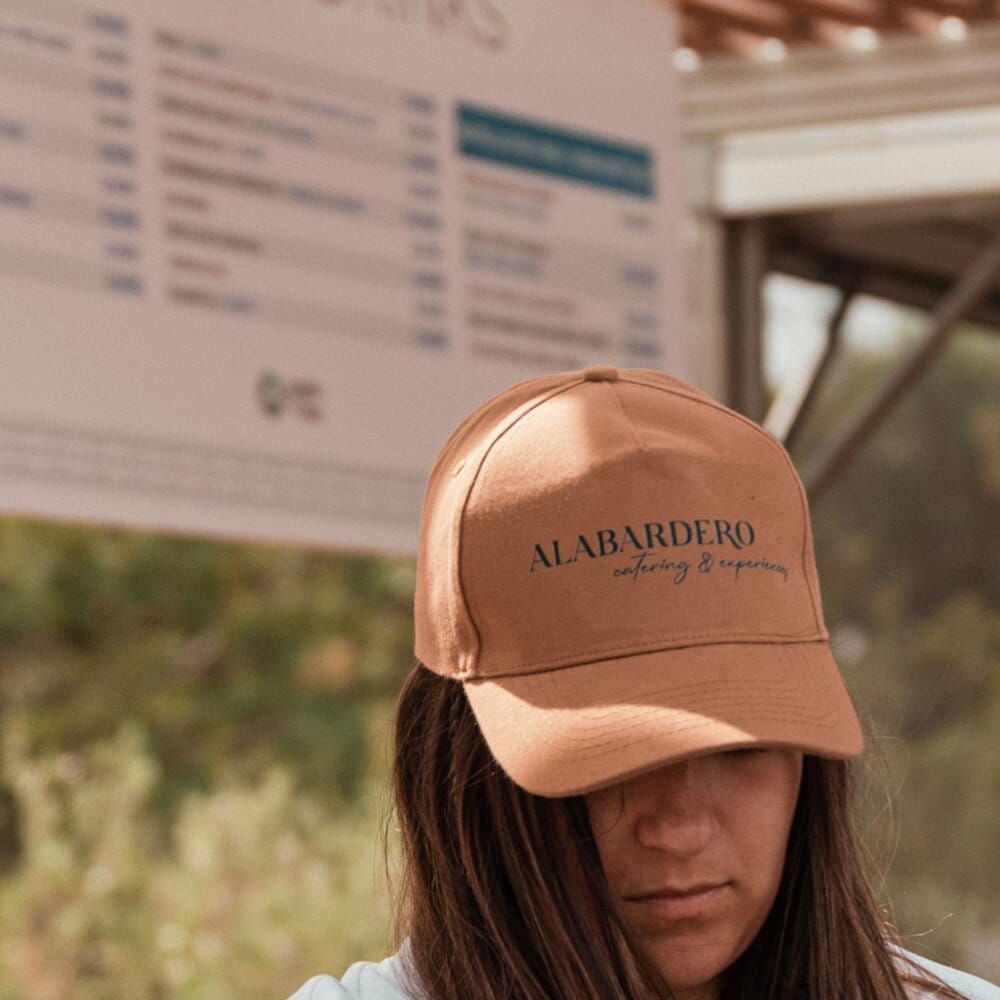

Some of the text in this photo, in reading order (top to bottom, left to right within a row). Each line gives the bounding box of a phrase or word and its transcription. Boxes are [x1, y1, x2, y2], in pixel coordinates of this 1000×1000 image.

[529, 519, 755, 572] ALABARDERO
[612, 551, 691, 585] catering
[698, 551, 714, 573] &
